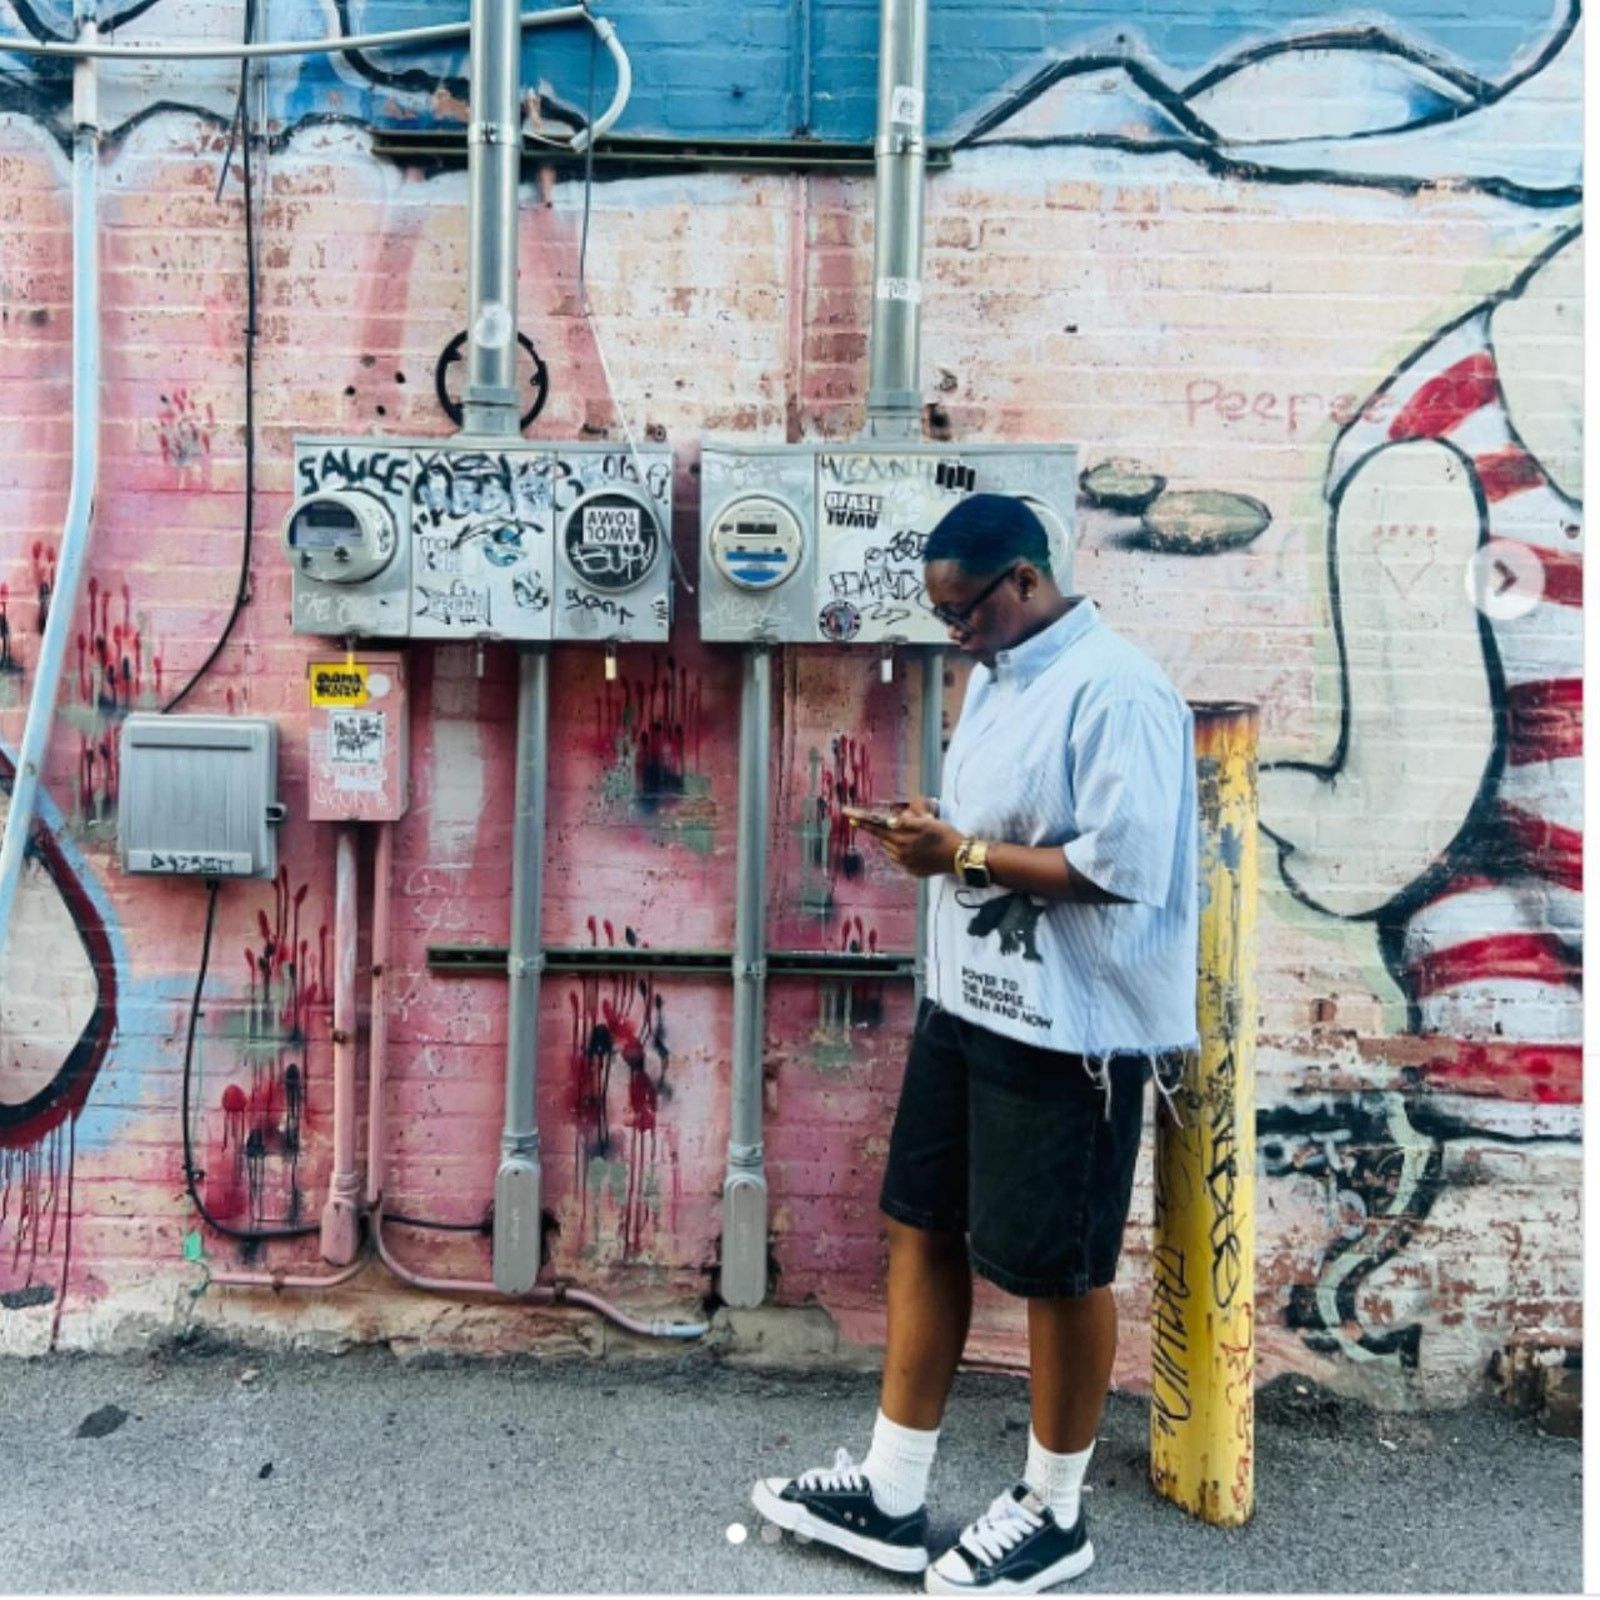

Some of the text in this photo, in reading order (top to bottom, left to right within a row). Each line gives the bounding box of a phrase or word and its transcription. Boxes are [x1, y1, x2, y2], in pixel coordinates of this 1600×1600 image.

[298, 449, 411, 497] SAUCE
[587, 510, 636, 526] AWOL
[962, 966, 1019, 992] POWER TO
[993, 1002, 1019, 1020] AND
[1022, 1010, 1054, 1030] NOW
